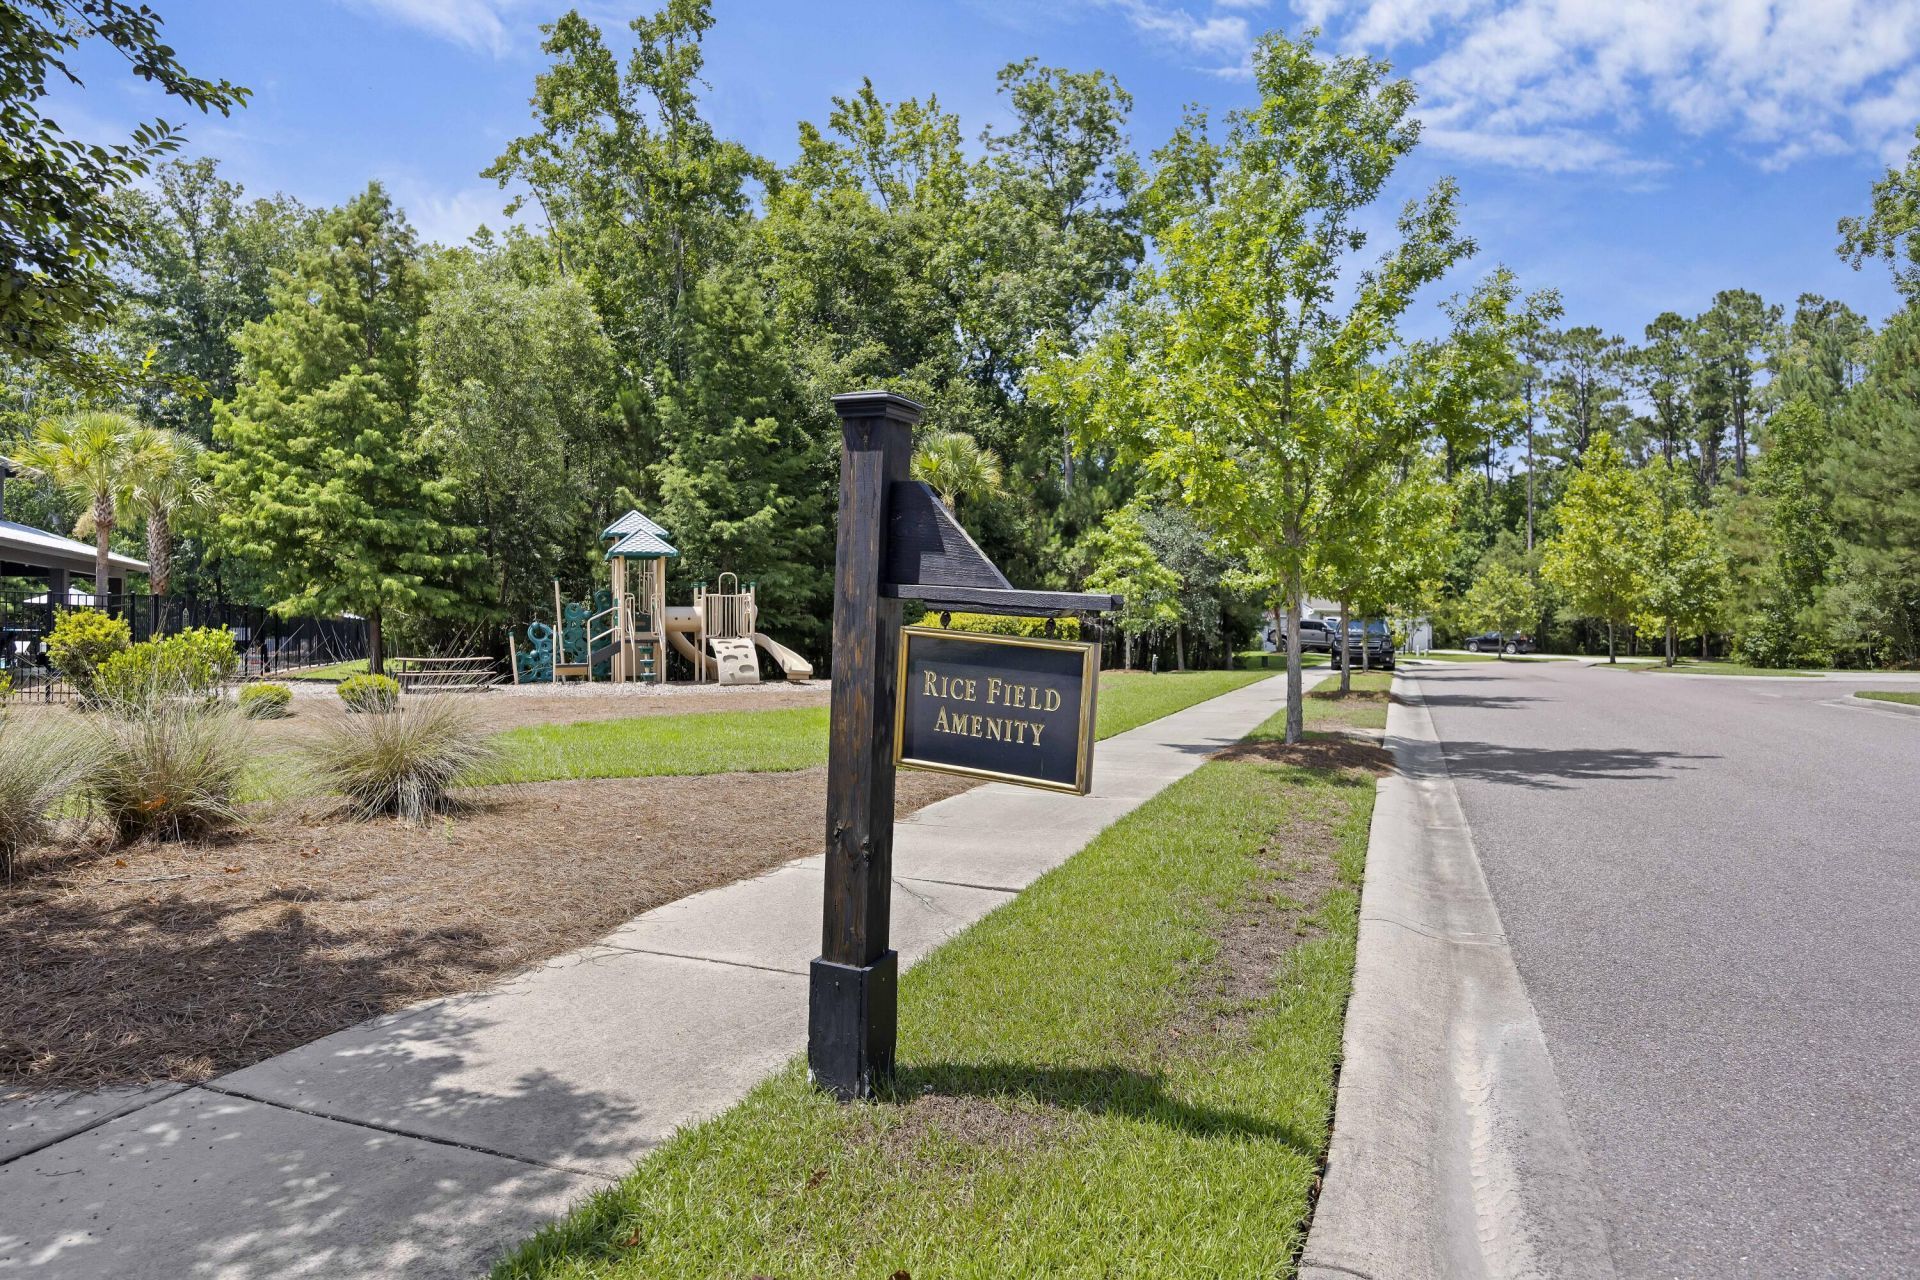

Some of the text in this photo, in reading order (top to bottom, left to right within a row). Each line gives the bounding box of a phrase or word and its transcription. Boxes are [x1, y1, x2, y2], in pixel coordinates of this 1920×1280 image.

[923, 670, 1062, 712] RICE FIELD
[933, 704, 1045, 746] AMENITY
